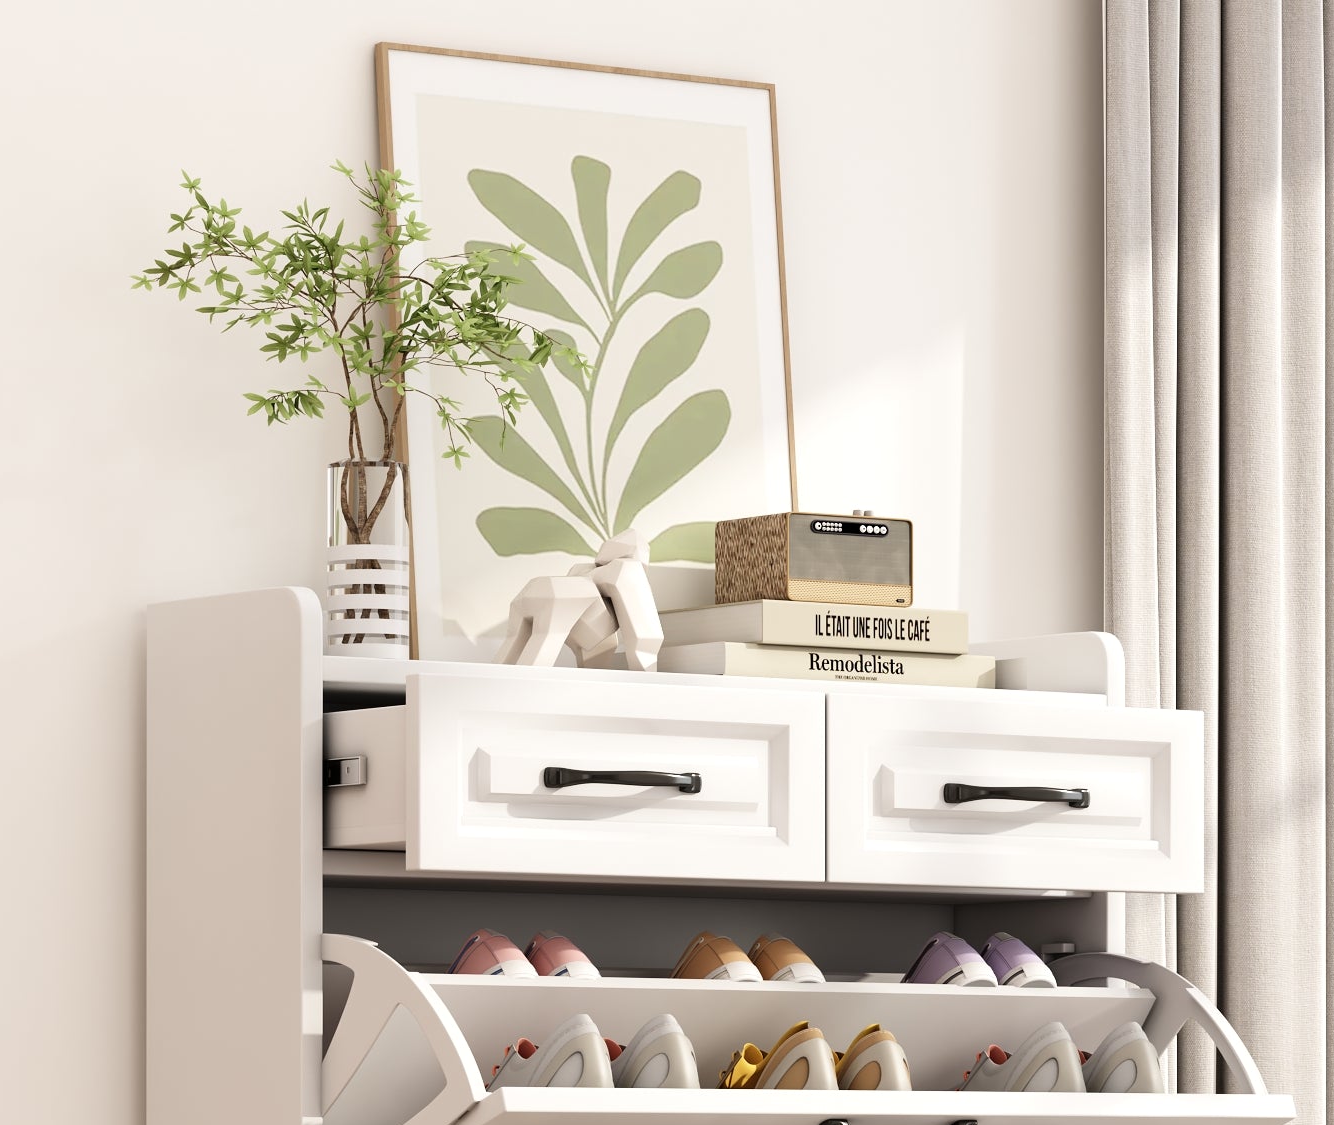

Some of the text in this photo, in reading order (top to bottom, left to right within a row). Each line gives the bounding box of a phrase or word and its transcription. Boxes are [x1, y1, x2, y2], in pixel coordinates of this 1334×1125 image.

[815, 610, 930, 641] IL ÉTAIT UNE FOIS LE CAFÉ
[808, 652, 904, 675] Remodelista
